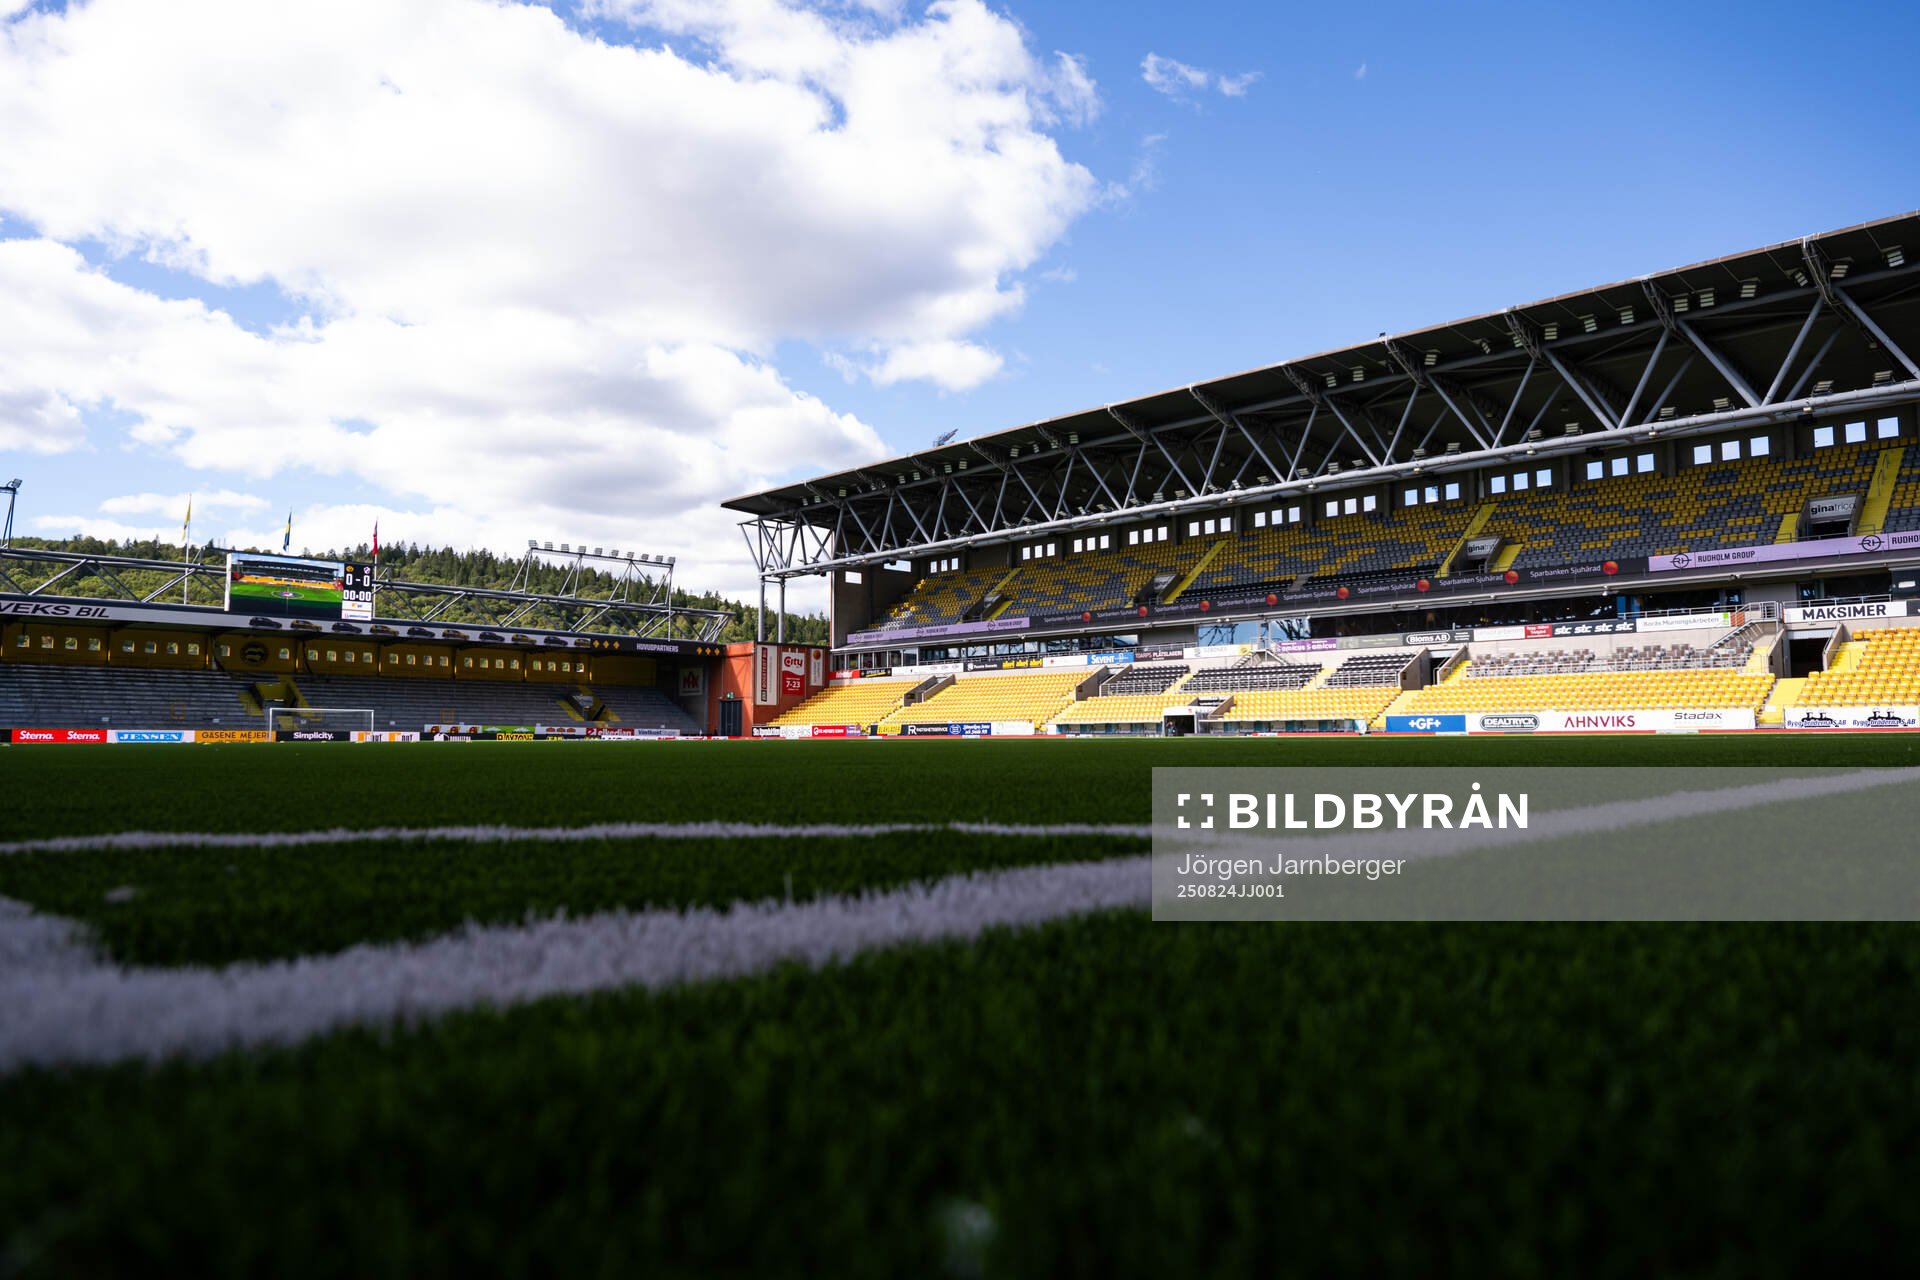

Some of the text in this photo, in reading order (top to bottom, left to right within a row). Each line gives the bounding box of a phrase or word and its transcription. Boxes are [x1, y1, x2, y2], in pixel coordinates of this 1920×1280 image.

[1698, 553, 1730, 563] RUDHOLM
[1732, 550, 1755, 560] GROUP
[1530, 565, 1601, 577] Sparbanken Sjuhärad
[346, 573, 353, 585] 0
[363, 574, 370, 587] 0
[1439, 577, 1475, 586] Sparbanken
[1358, 584, 1389, 594] Sparbanken
[343, 590, 372, 601] 00:00
[75, 606, 110, 618] BIL
[1802, 604, 1886, 620] MAKSIMER
[1554, 624, 1571, 635] stc
[1574, 623, 1592, 634] stc
[1594, 622, 1612, 633] stc
[1615, 621, 1634, 632] stc
[1410, 633, 1434, 643] Bloms
[1435, 632, 1447, 641] AB
[637, 643, 679, 652] HUVUDPARTNERS
[1312, 641, 1336, 650] amicus
[784, 656, 803, 667] City
[1564, 715, 1635, 728] AHNVIKS
[1674, 712, 1723, 720] Stadax
[293, 732, 334, 740] Simplicity.
